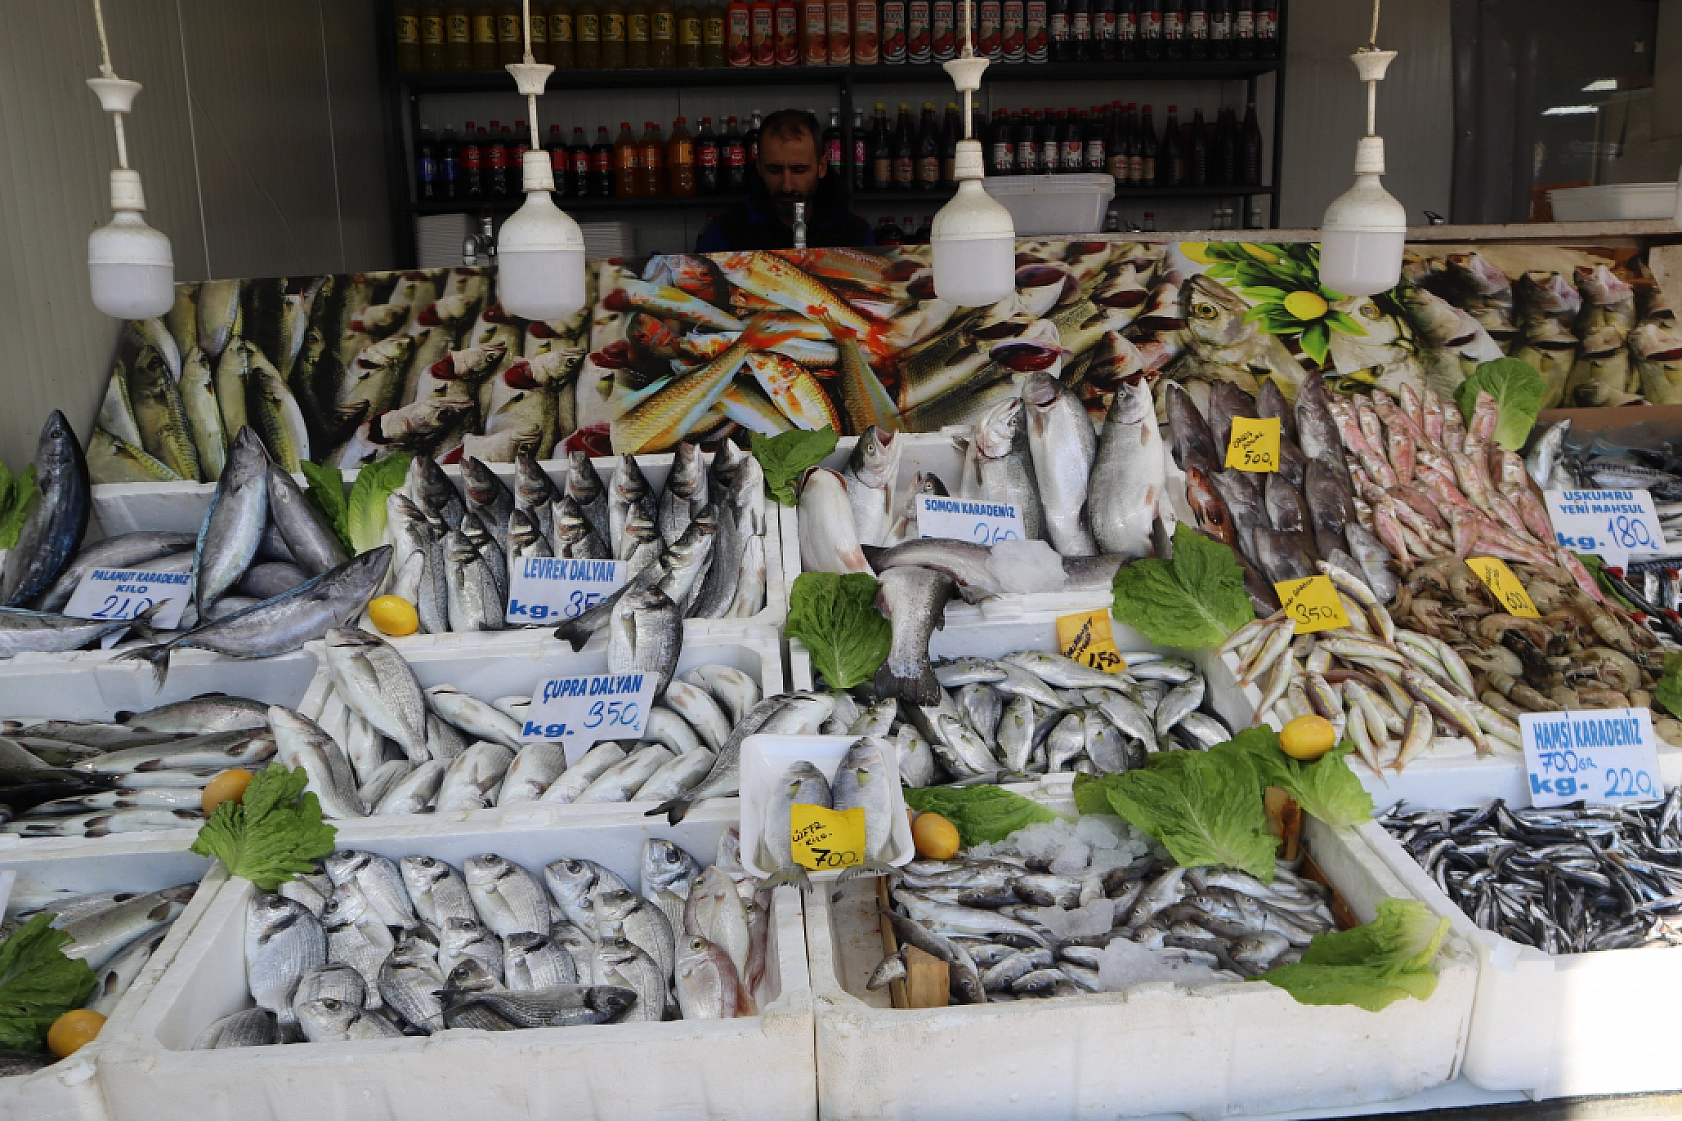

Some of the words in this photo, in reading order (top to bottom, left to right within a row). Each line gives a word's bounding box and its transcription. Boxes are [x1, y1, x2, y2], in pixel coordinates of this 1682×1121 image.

[1563, 491, 1634, 501] USKUMRU
[925, 497, 960, 514] SOMON
[961, 502, 1016, 519] KARADENİZ
[1558, 501, 1590, 514] YENİ
[1592, 504, 1646, 514] MAHSUL
[1556, 531, 1606, 550] kg.
[91, 569, 137, 583] PALAMUT
[135, 571, 191, 586] KARADENİZ
[523, 558, 569, 580] LEVREK
[569, 560, 615, 582] DALYAN
[510, 599, 559, 619] kg.
[542, 676, 588, 705] ÇUPRA
[589, 674, 644, 696] DALYAN
[523, 721, 574, 738] kg.
[1532, 711, 1573, 750] HAMSİ
[1573, 708, 1643, 748] KARADENİZ
[1529, 772, 1589, 797] kg.
